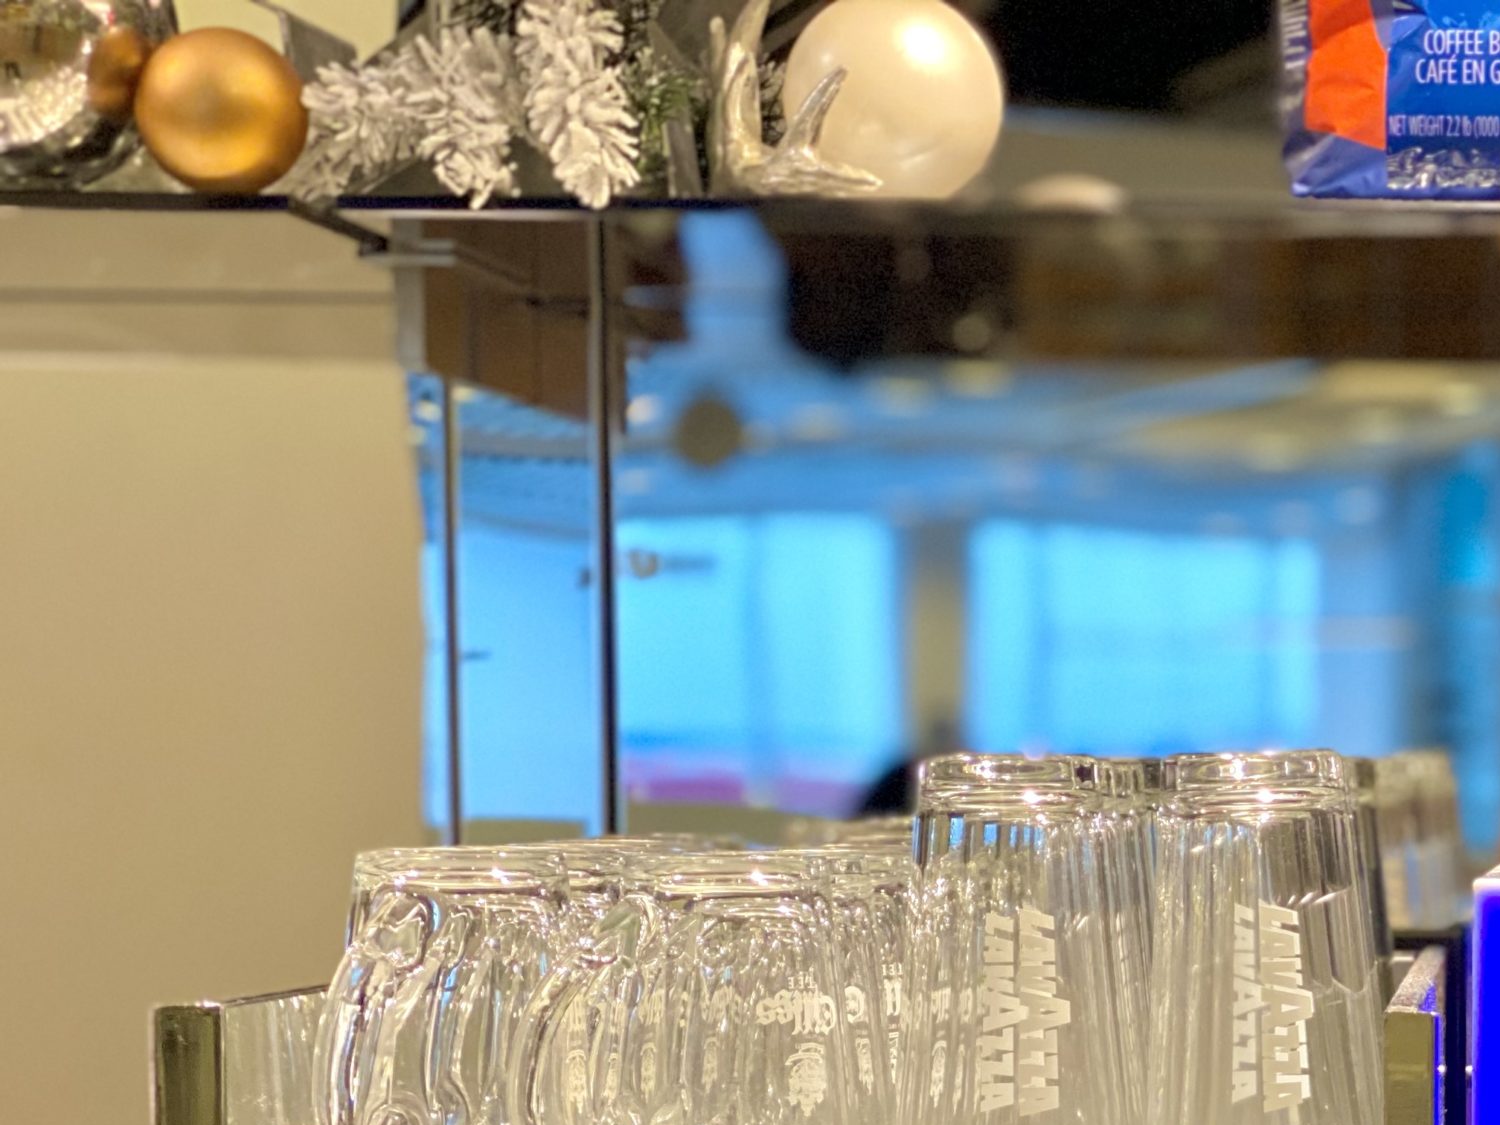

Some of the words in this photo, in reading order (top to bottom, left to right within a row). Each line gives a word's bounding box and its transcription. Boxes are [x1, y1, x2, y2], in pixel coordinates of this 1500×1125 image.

[1424, 29, 1484, 55] COFFEE
[1415, 54, 1458, 84] CAFÉ
[1462, 59, 1485, 84] EN
[1389, 115, 1406, 136] NET
[1408, 115, 1444, 136] WEIGHT
